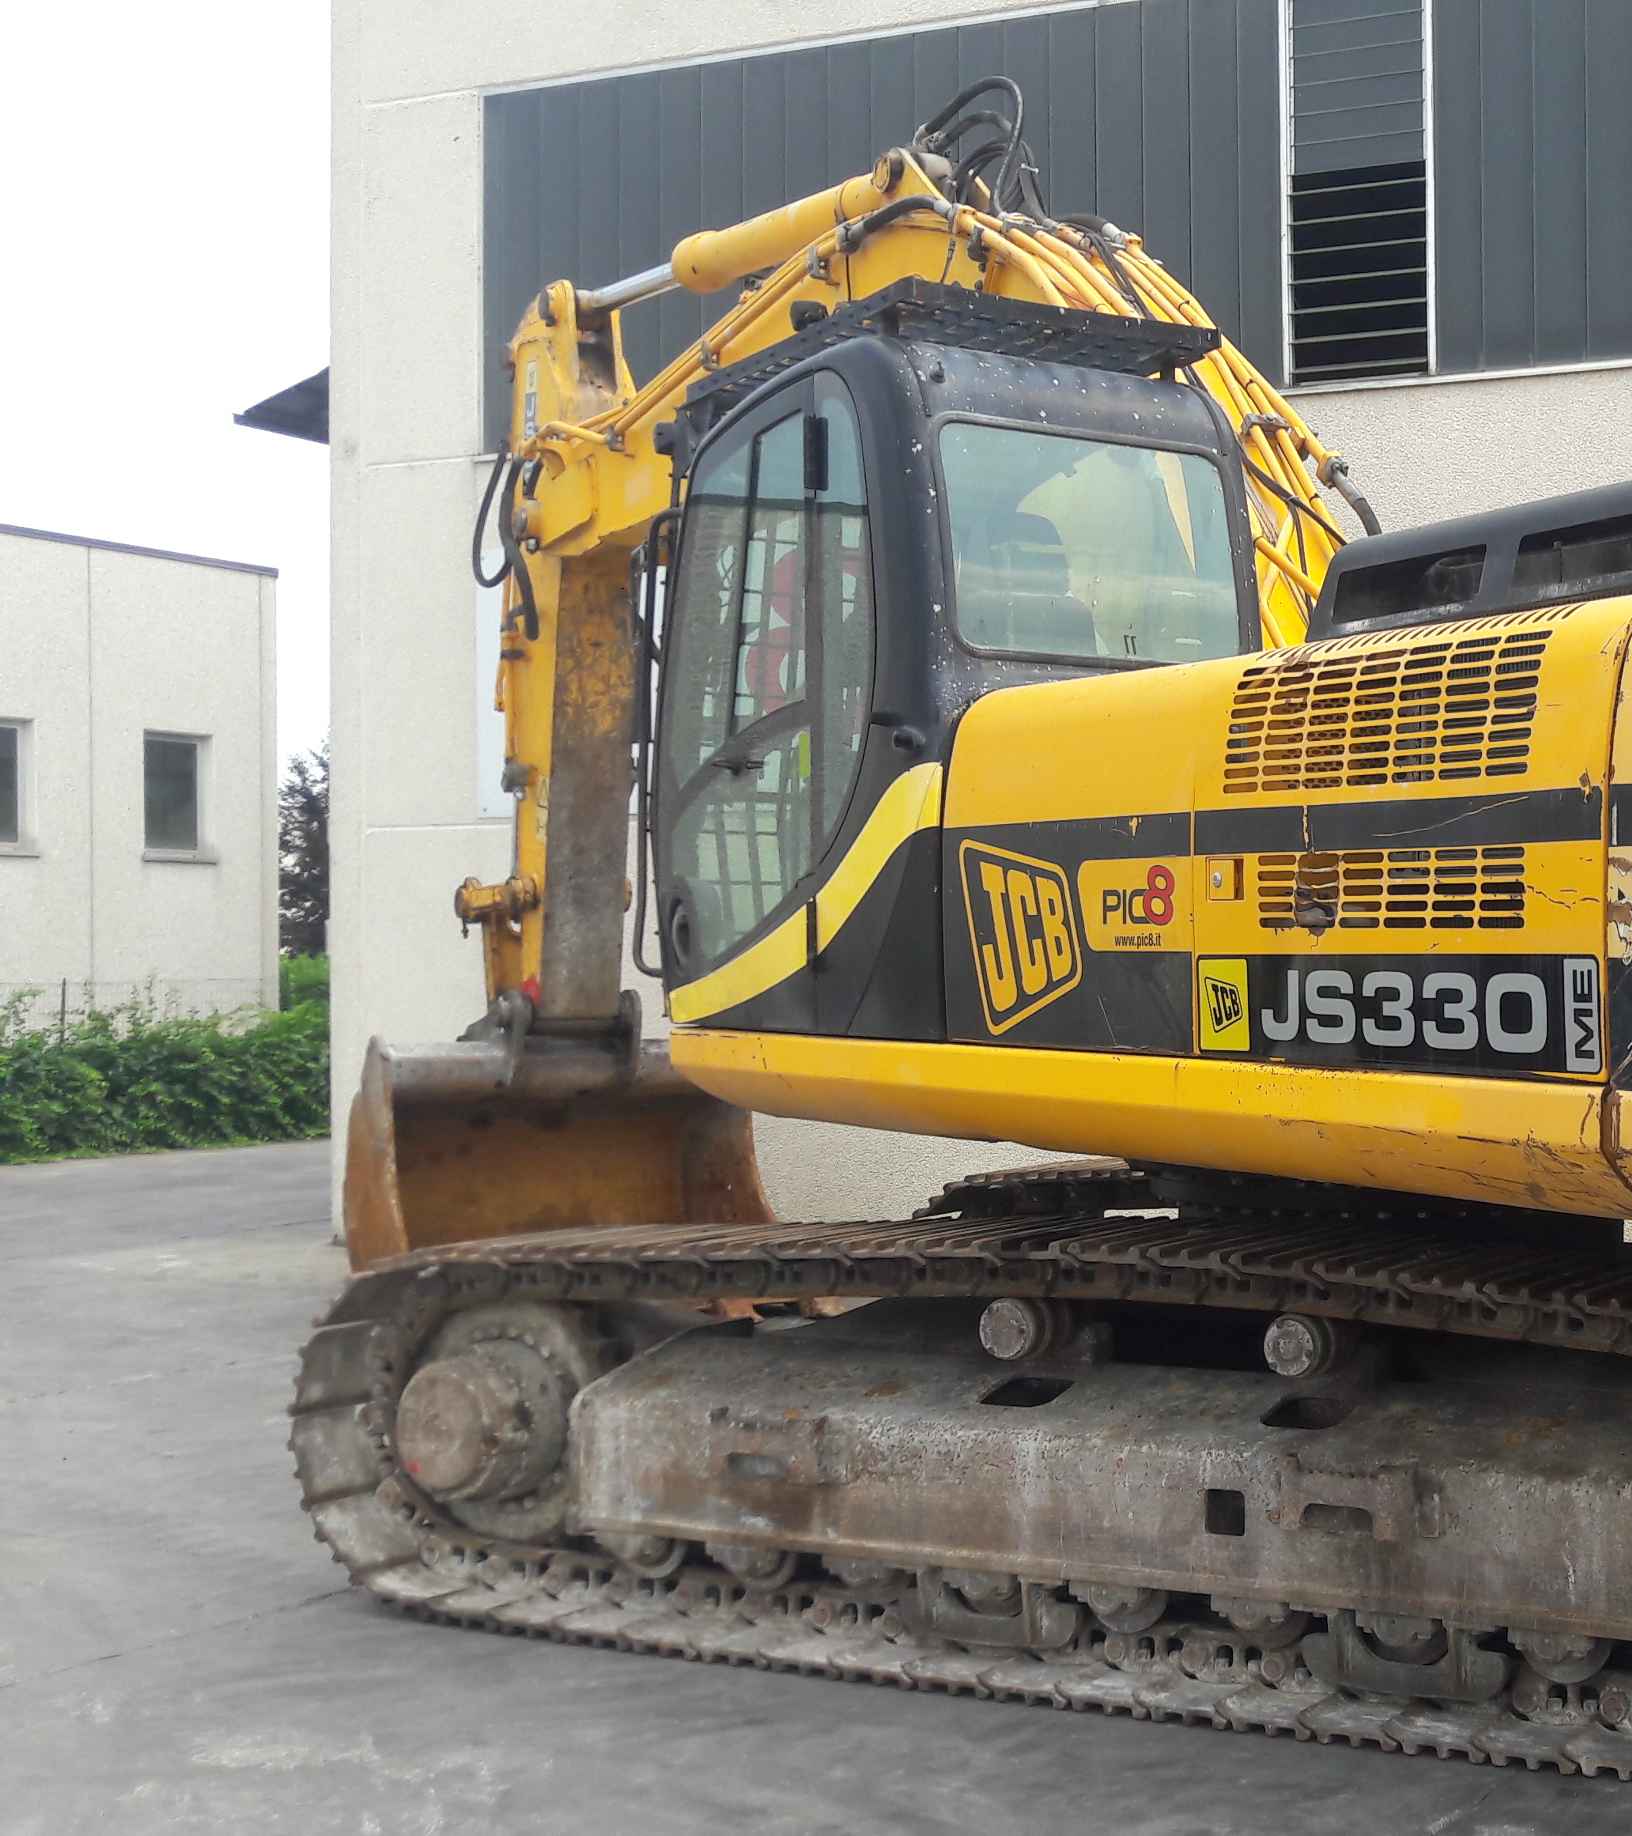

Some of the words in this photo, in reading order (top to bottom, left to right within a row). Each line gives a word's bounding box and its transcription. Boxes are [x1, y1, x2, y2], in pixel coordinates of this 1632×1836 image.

[1103, 864, 1175, 926] PIC8
[979, 861, 1073, 1013] JCB
[1114, 933, 1162, 949] www.pic8.it
[1211, 984, 1240, 1027] JCB
[1261, 968, 1548, 1054] JS330
[1572, 969, 1595, 1059] ME
